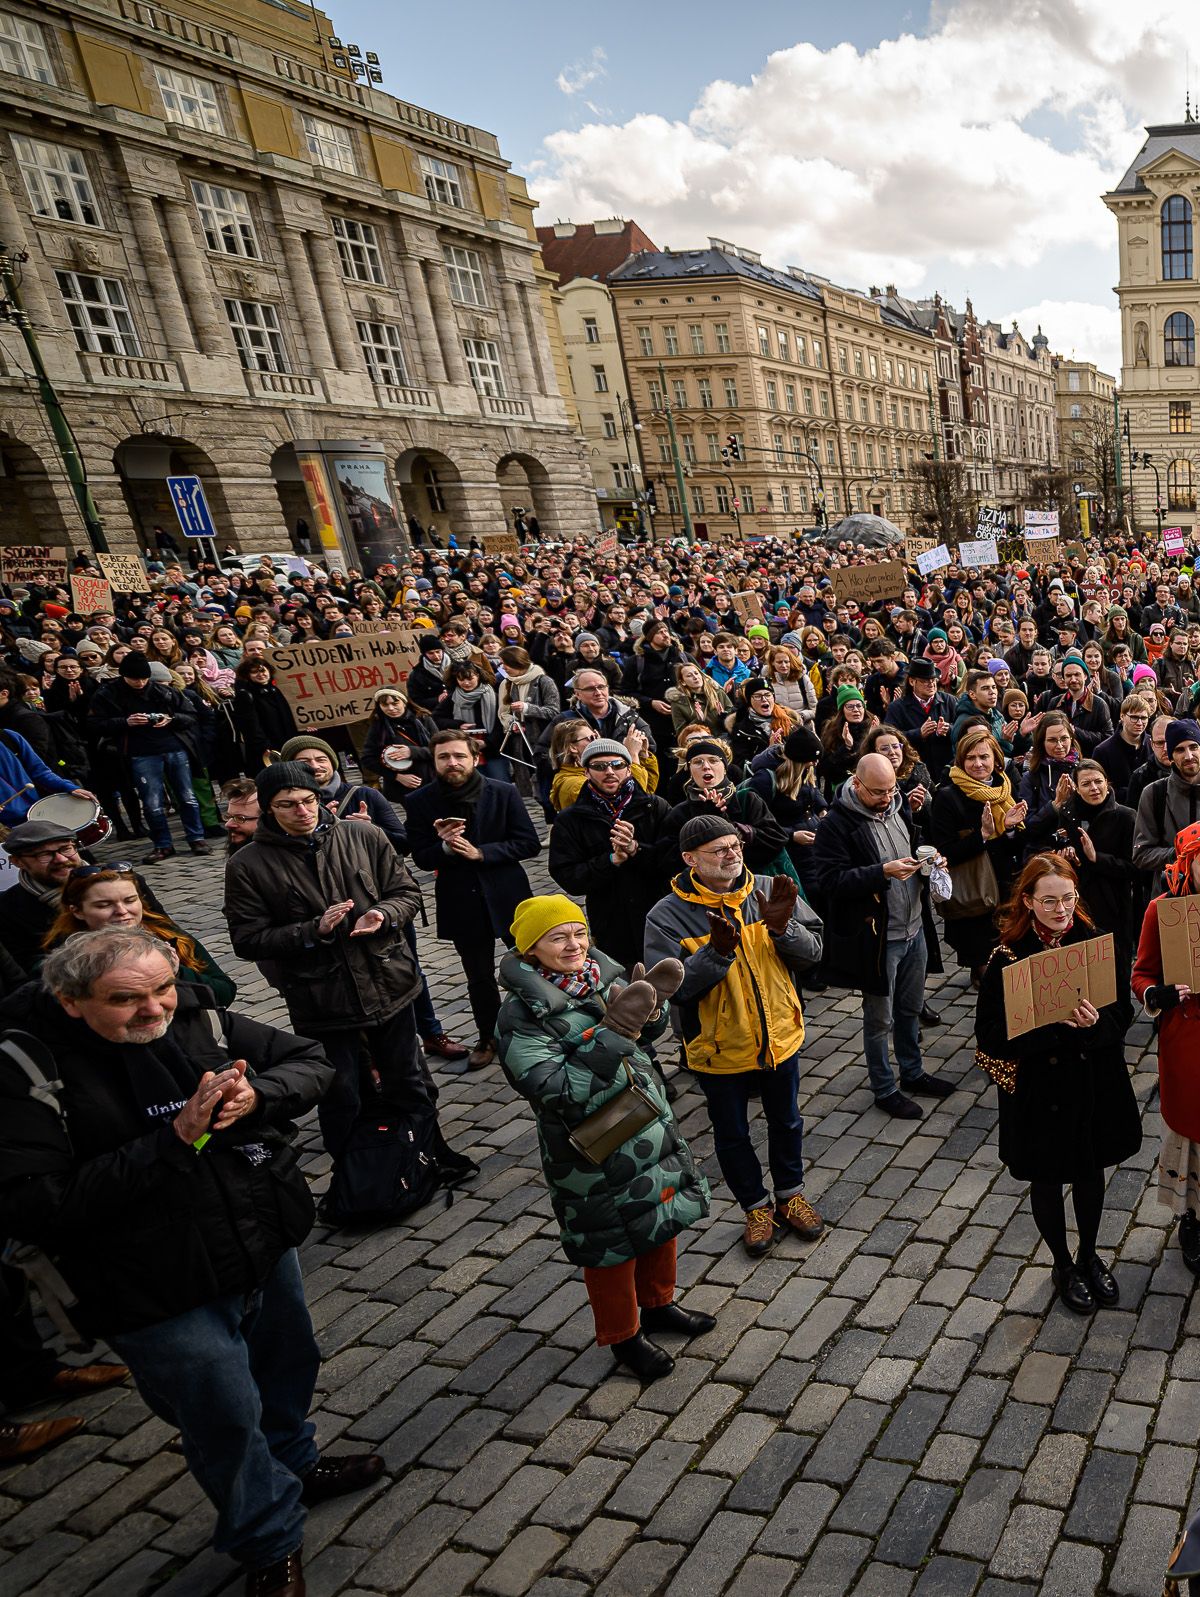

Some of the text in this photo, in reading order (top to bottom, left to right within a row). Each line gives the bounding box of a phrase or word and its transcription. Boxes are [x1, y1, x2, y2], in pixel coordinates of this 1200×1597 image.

[907, 540, 923, 549] FHS
[110, 555, 128, 563] BEZ
[313, 665, 385, 696] HUDBA
[1010, 937, 1113, 994] INDOLOGIE
